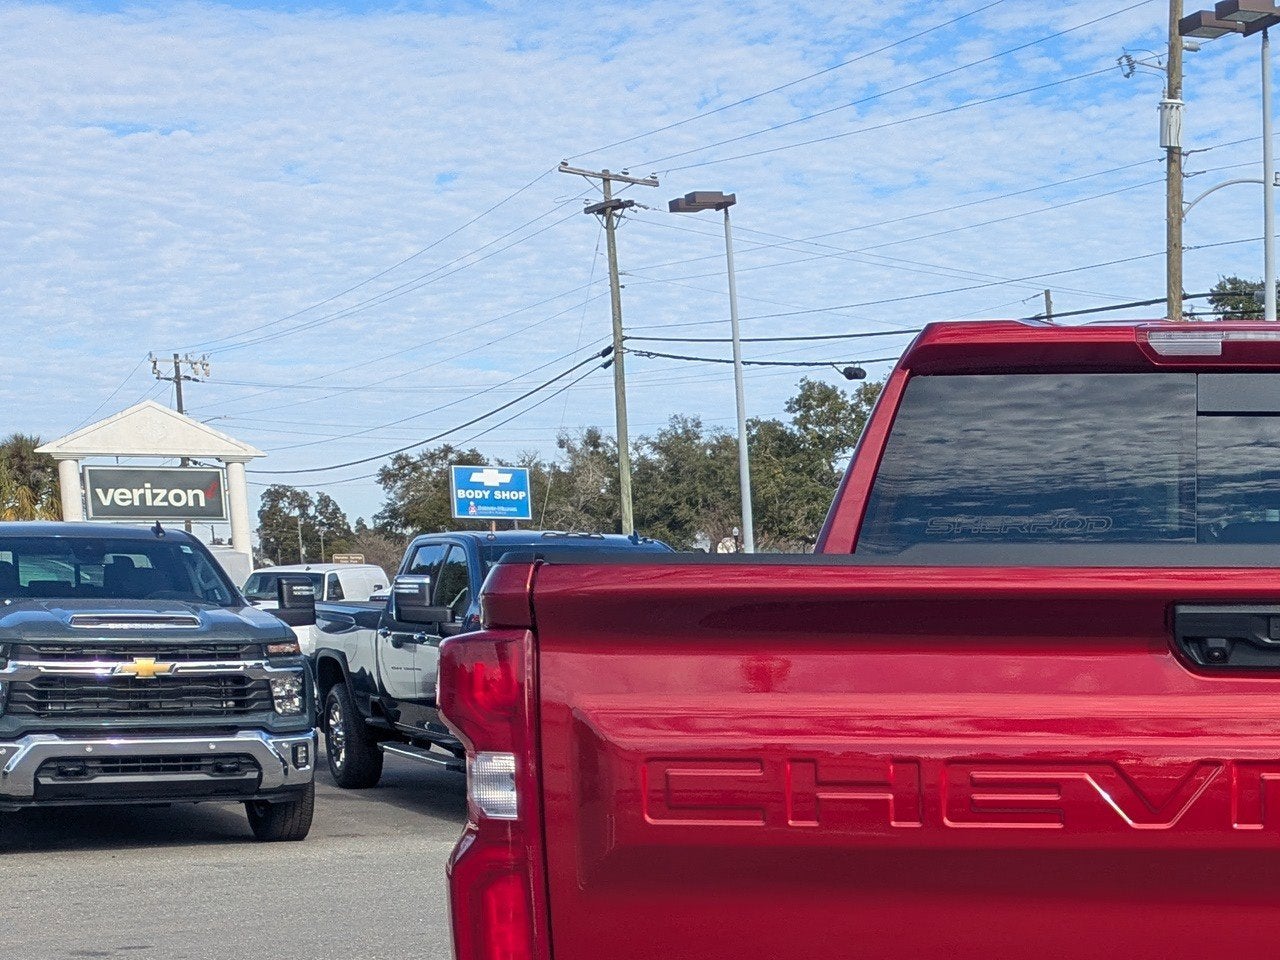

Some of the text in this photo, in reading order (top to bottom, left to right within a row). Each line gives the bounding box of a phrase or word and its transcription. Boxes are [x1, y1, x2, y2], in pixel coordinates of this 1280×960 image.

[95, 482, 206, 507] verizon
[457, 489, 526, 500] BODY SHOP
